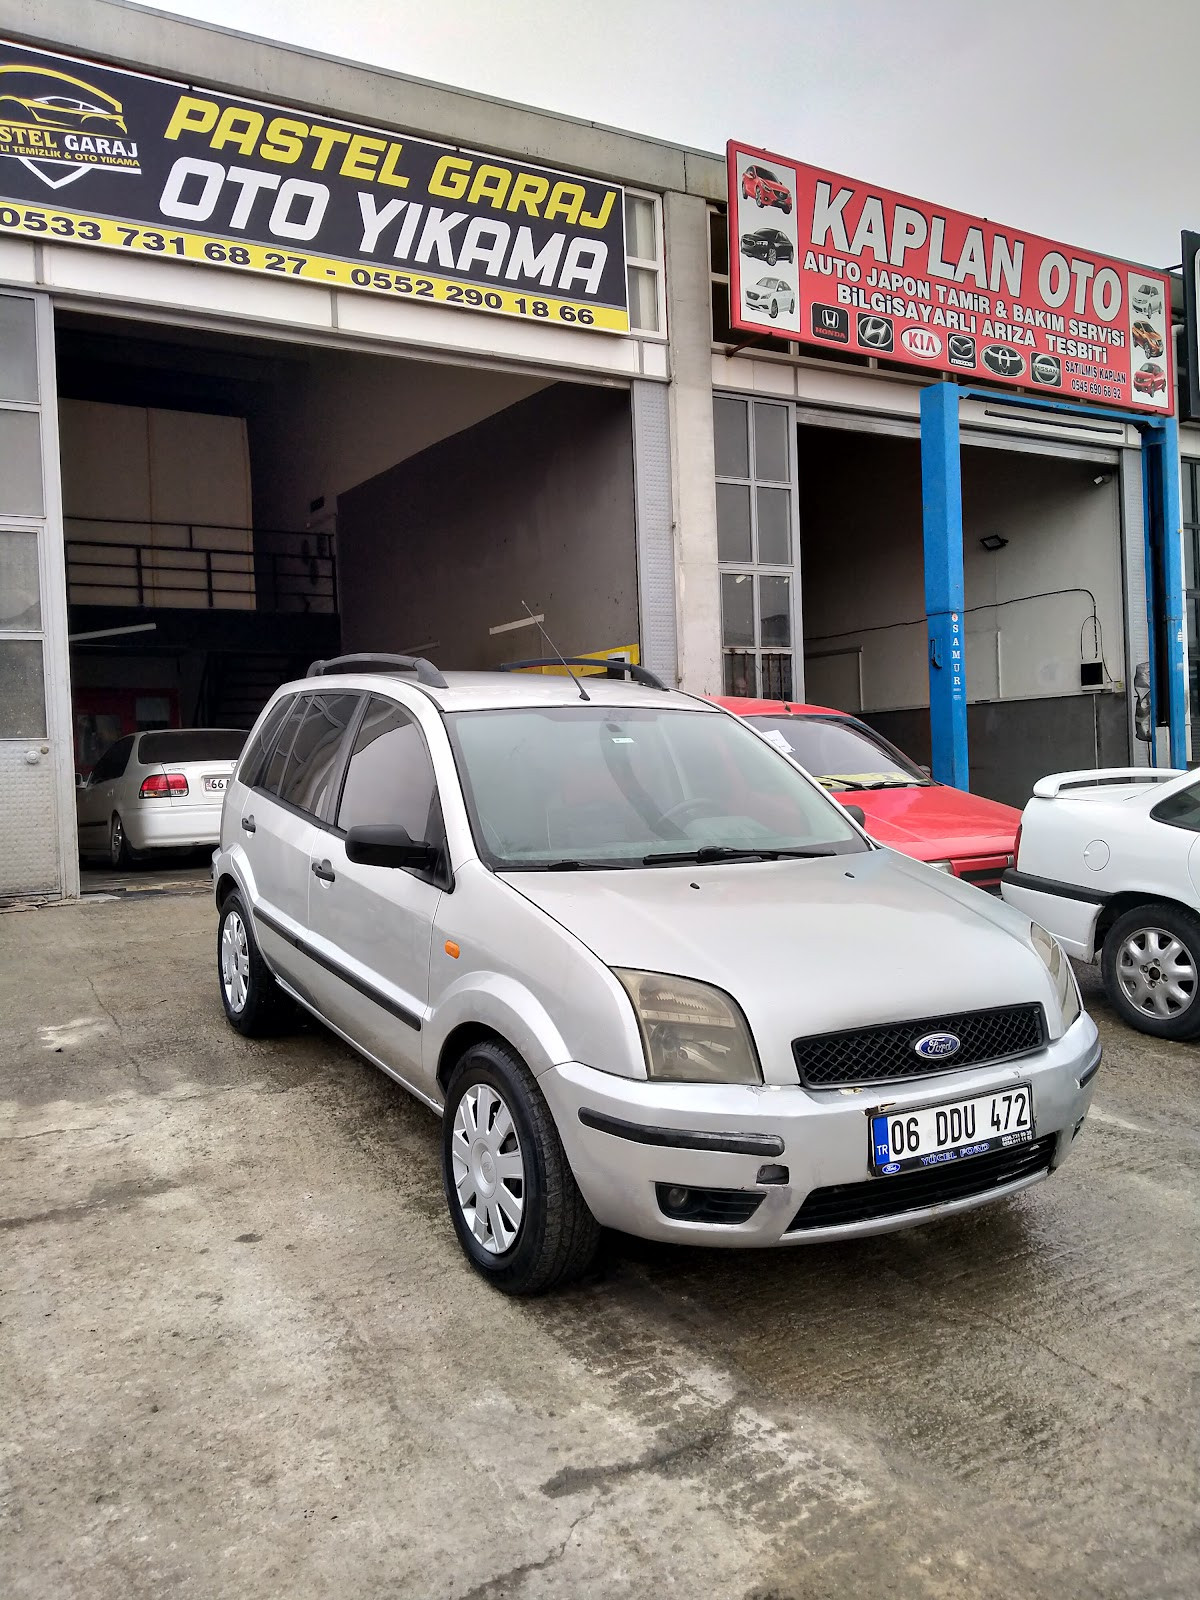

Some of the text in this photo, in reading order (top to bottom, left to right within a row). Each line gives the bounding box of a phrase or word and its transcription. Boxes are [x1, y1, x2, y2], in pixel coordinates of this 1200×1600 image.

[64, 135, 138, 157] GARAJ
[75, 153, 97, 162] OTO
[100, 156, 140, 166] YIKAMA
[164, 96, 616, 229] PASTEL GARAJ
[159, 157, 608, 294] OTO YIKAMA
[811, 179, 1122, 322] KAPLAN OTO
[0, 207, 101, 241] 0533
[117, 226, 185, 256] 731
[203, 242, 251, 265] 68
[265, 252, 307, 275] 27
[350, 268, 434, 298] 0552
[446, 285, 502, 309] 290
[515, 298, 549, 318] 18
[559, 305, 595, 325] 66
[803, 250, 861, 282] AUTO
[866, 267, 931, 300] JAPON
[995, 300, 1008, 319] &
[1013, 304, 1065, 333] BAKIM
[815, 327, 846, 339] HONDA
[908, 332, 936, 353] KIA
[982, 319, 1037, 347] ARIZA
[1034, 364, 1059, 375] NISSAN
[1099, 368, 1127, 385] KAPLAN
[1071, 378, 1088, 393] 0545
[952, 624, 961, 685] SAMUR
[211, 780, 224, 789] 66
[927, 1037, 953, 1053] Ford
[891, 1117, 920, 1155] 06
[935, 1104, 976, 1146] DDU
[991, 1093, 1028, 1132] 472
[877, 1144, 889, 1156] TR
[921, 1143, 990, 1166] YÜCEL FORD
